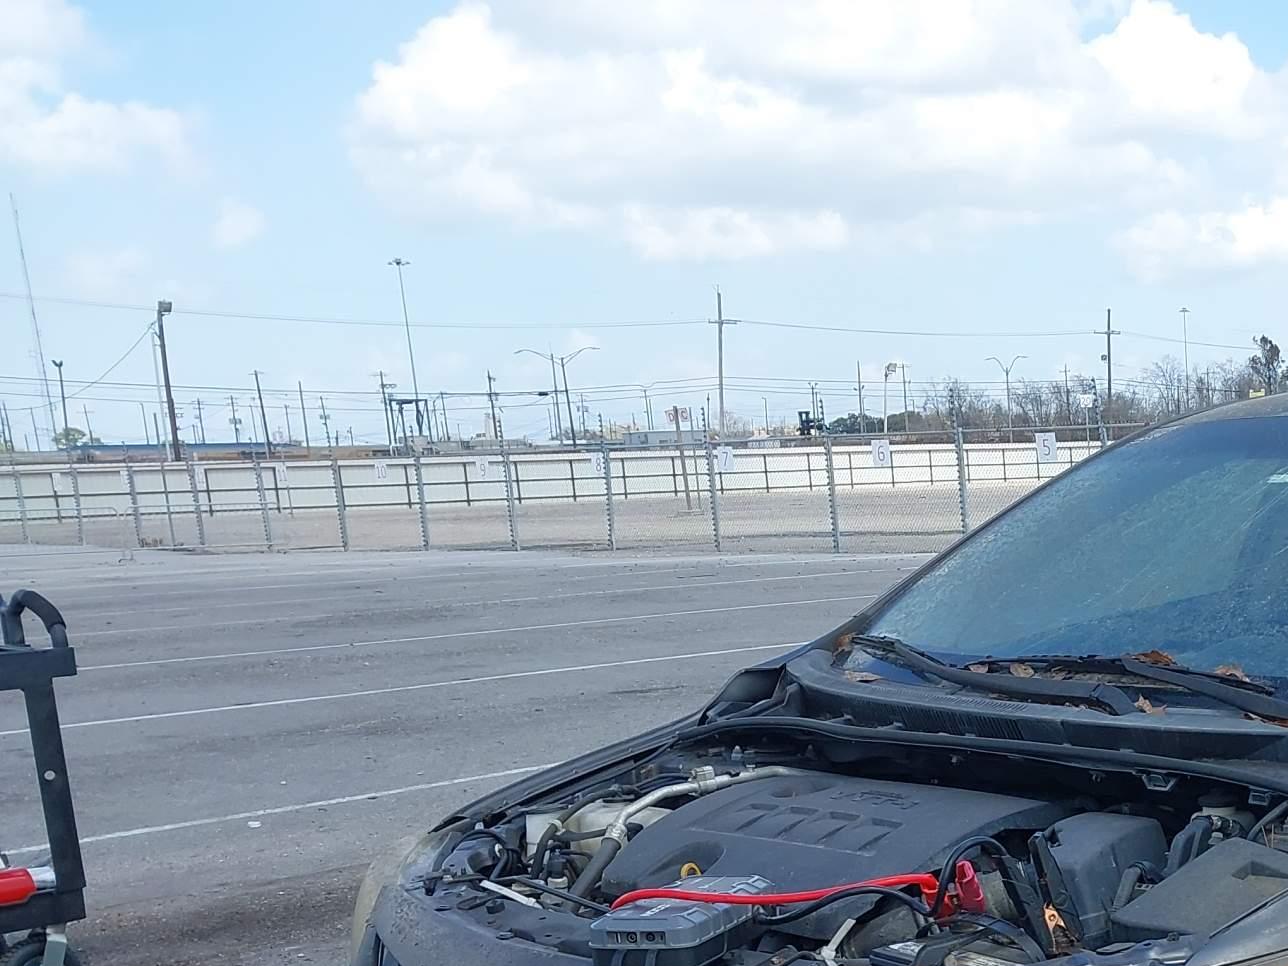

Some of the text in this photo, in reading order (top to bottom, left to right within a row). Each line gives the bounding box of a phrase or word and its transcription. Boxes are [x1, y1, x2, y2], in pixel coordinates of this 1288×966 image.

[877, 445, 886, 462] 6
[1042, 438, 1051, 456] 5
[595, 457, 602, 472] 8
[722, 451, 729, 467] 7
[376, 465, 388, 479] 10
[479, 463, 487, 477] 9
